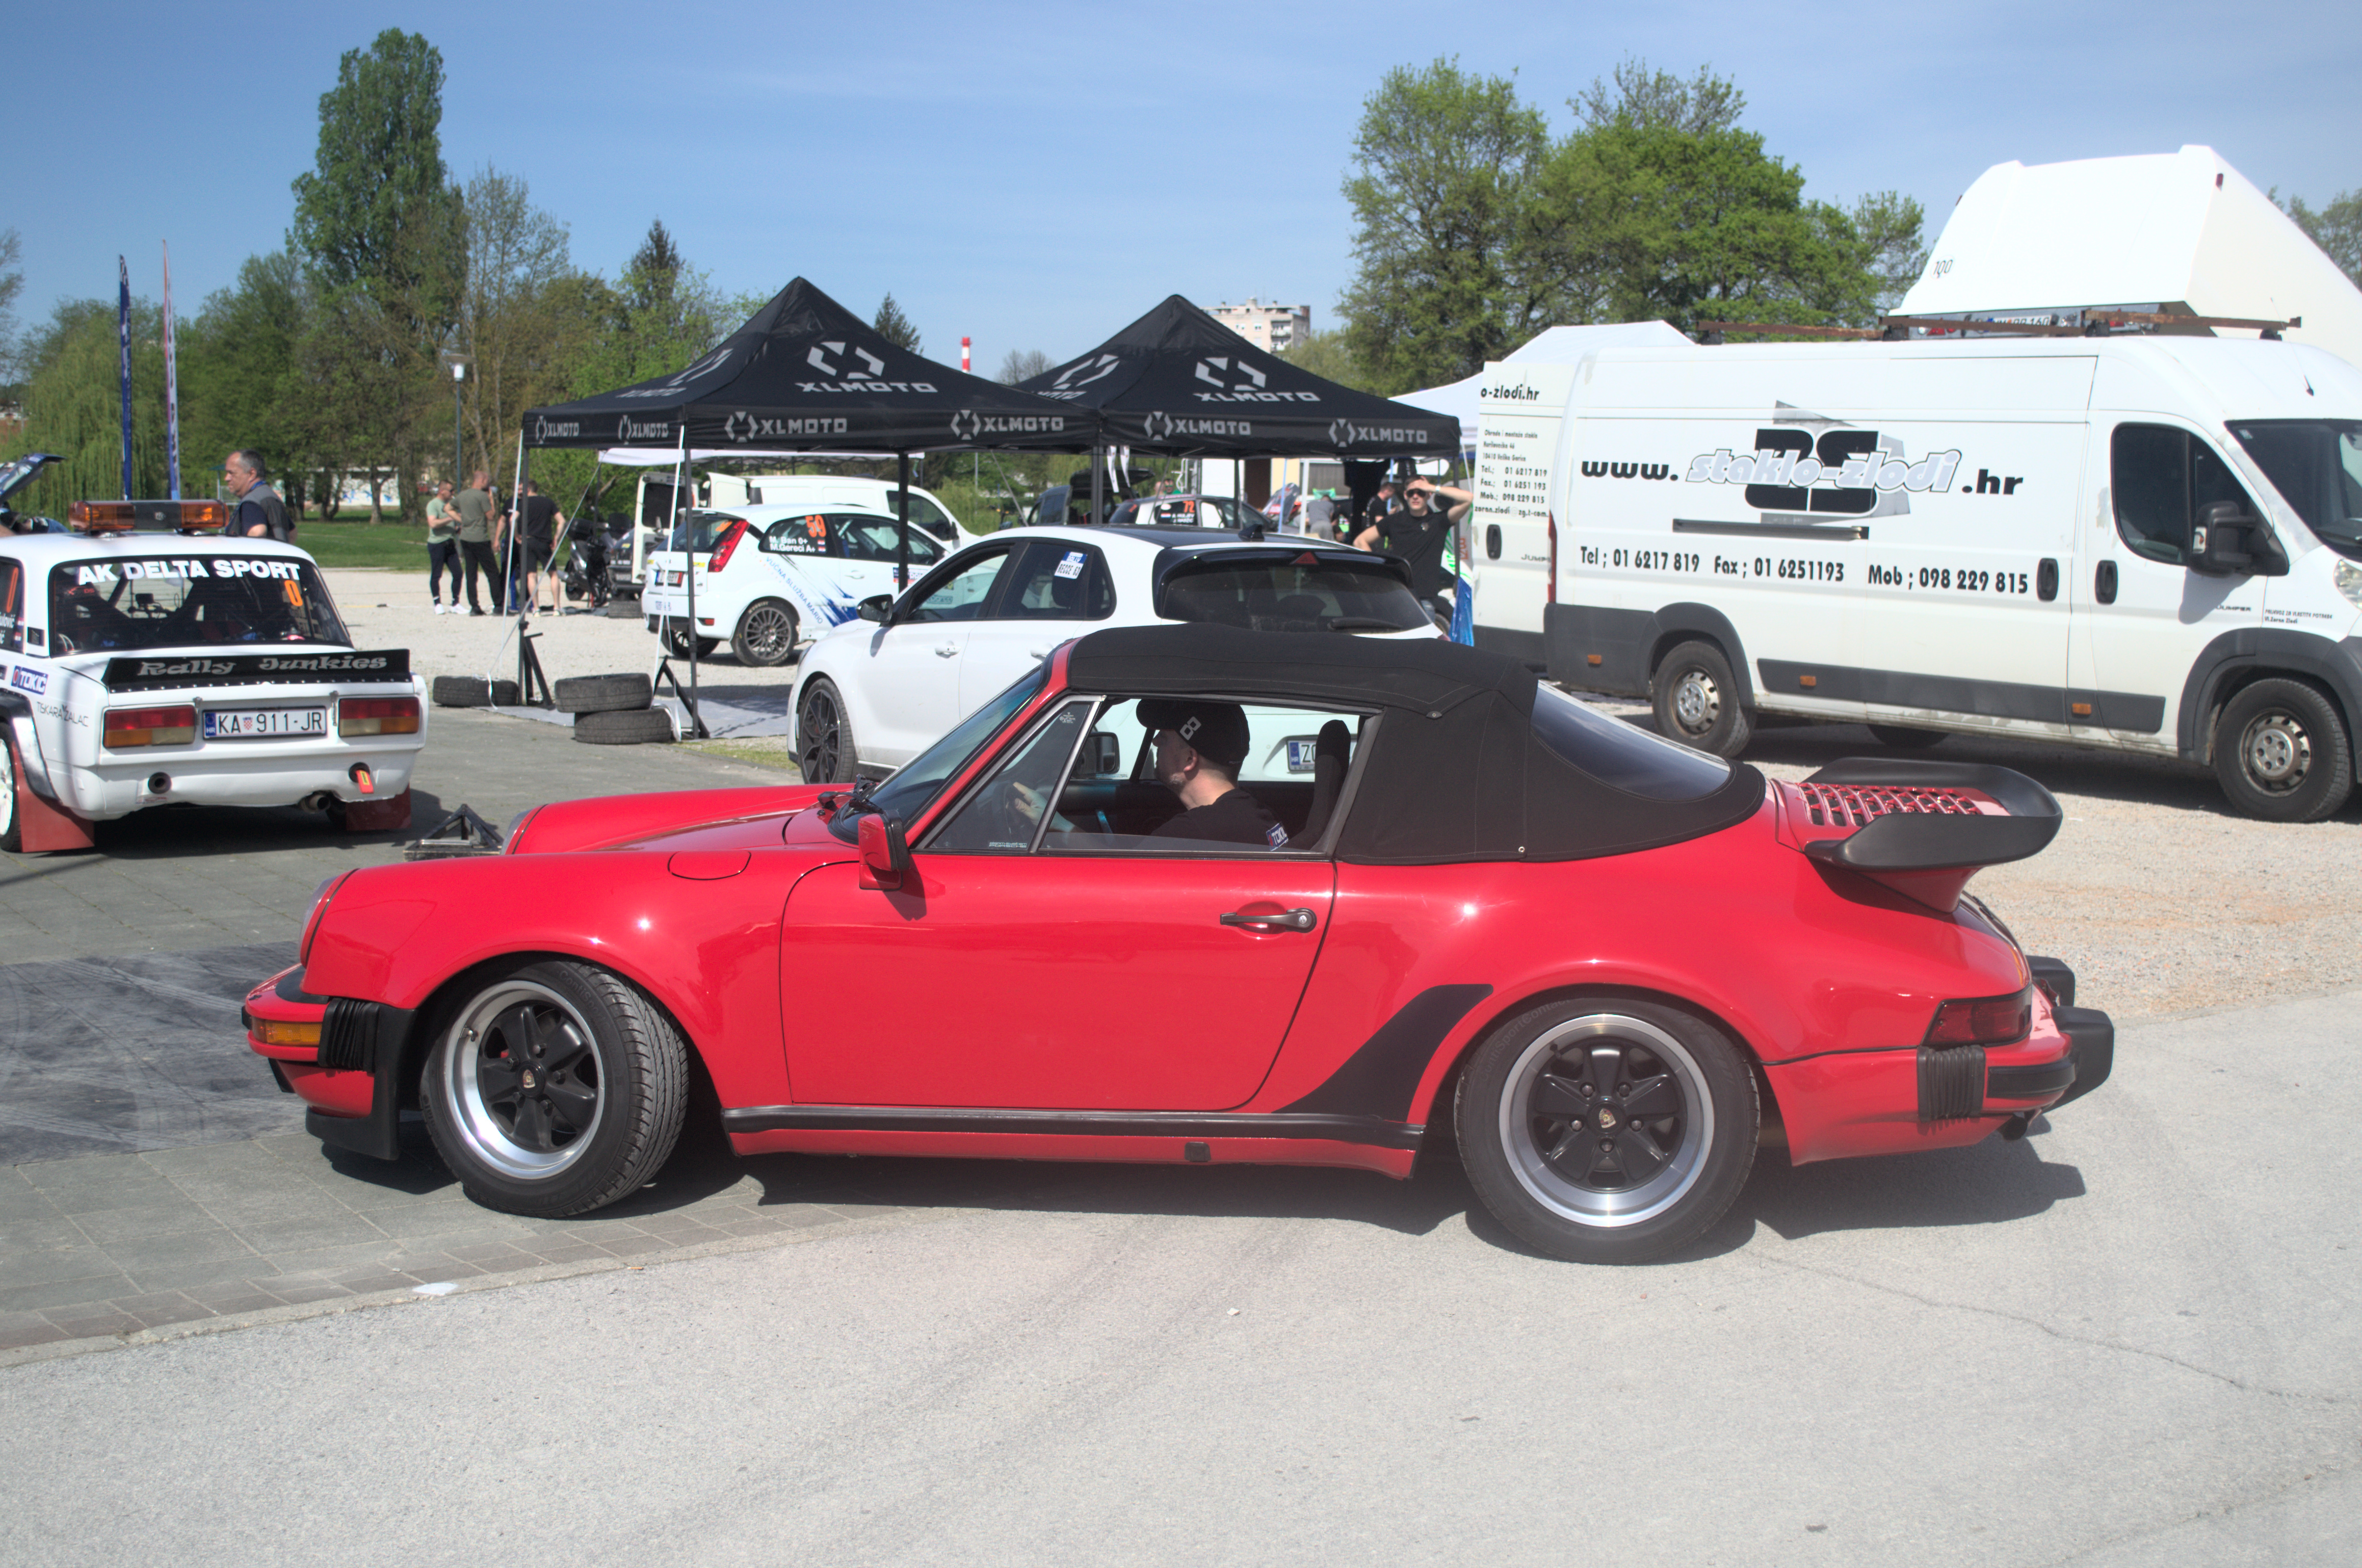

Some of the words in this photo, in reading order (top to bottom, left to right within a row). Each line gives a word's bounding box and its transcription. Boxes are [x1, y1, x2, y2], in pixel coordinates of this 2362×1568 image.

[1933, 259, 1953, 276] 100
[795, 382, 938, 393] XLMOTO
[1481, 384, 1539, 400] o-zlodi.hr
[1192, 392, 1321, 402] XLMOTO
[547, 423, 580, 437] XLMOTO
[632, 423, 669, 438] XLMOTO
[760, 417, 847, 435] XLMOTO
[983, 416, 1064, 432] XLMOTO
[1175, 420, 1251, 435] XLMOTO
[1357, 426, 1428, 444] XLMOTO
[1505, 466, 1512, 475] 01
[1515, 467, 1532, 476] 6217
[1535, 468, 1547, 477] 819
[1504, 480, 1511, 488] 01
[1514, 481, 1531, 489] 6251
[1534, 482, 1546, 490] 193
[1503, 493, 1514, 501] 098
[1517, 494, 1529, 503] 229
[1532, 495, 1544, 504] 815
[1183, 501, 1195, 513] 72
[805, 514, 826, 538] 59
[780, 536, 797, 544] Ban
[806, 544, 816, 553] A+
[1581, 546, 1598, 565] Tel
[1613, 548, 1628, 567] 01
[1635, 551, 1668, 570] 6217
[1673, 553, 1699, 572] 819
[78, 563, 121, 585] AK
[123, 560, 210, 580] DELTA
[213, 560, 301, 581] SPORT
[1057, 564, 1073, 575] RECCE
[1714, 556, 1738, 575] Fax
[1754, 557, 1770, 577] 01
[1778, 559, 1844, 582] 6251193
[1868, 564, 1902, 586] Mob
[1919, 567, 1950, 589] 098
[1957, 569, 1988, 591] 229
[1995, 571, 2028, 594] 815
[284, 580, 303, 607] 0
[806, 602, 823, 624] MARIO
[138, 660, 237, 676] Rally
[258, 655, 387, 670] Junkies
[19, 670, 47, 693] TOKIĆ
[218, 715, 241, 734] KA
[256, 712, 322, 733] 911-JR
[1271, 826, 1287, 845] TOKI
